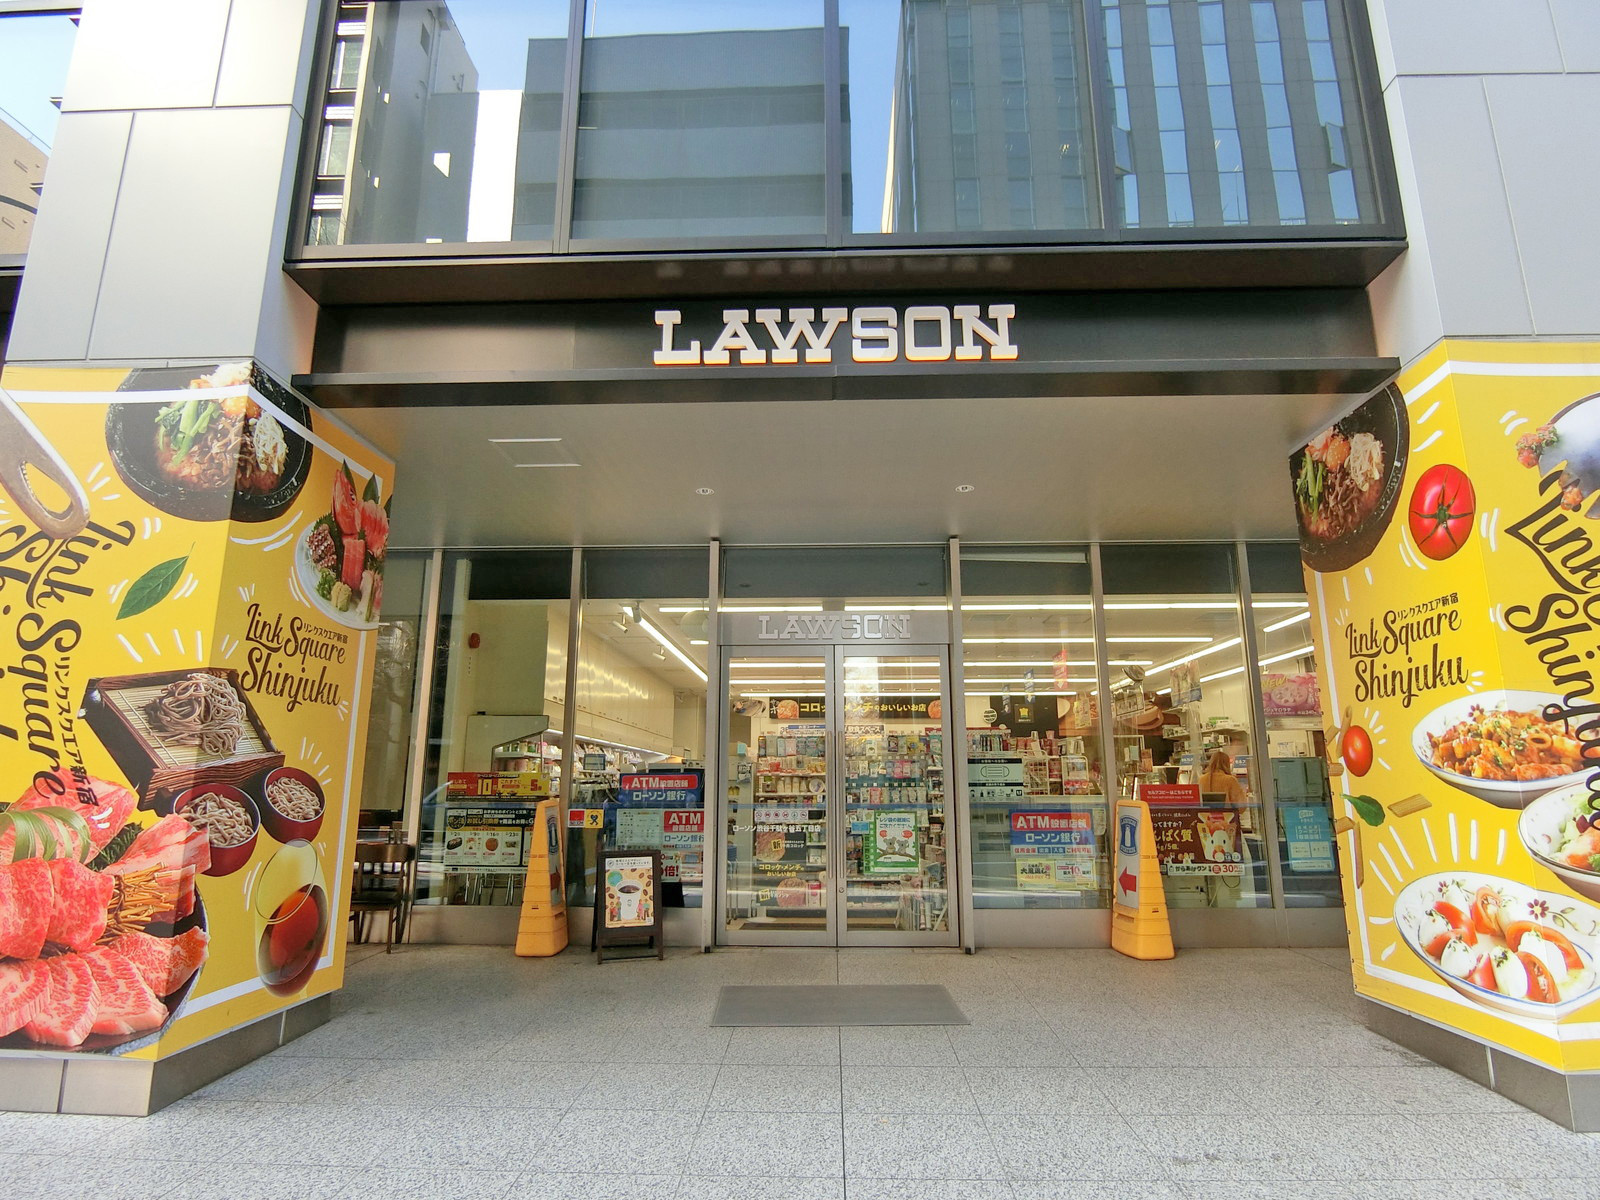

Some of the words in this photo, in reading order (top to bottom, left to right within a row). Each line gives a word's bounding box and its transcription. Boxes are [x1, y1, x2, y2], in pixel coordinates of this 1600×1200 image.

[653, 303, 1018, 365] LAWSON
[26, 520, 136, 609] Link
[245, 603, 284, 653] Link
[284, 616, 346, 665] Square
[303, 622, 348, 645] リンクスクエア新宿
[757, 615, 911, 640] LAWSON
[1345, 618, 1382, 659] Link
[1383, 609, 1462, 656] Square
[1397, 592, 1459, 621] リンクスクエア新宿
[241, 647, 341, 713] Shinjuku
[1355, 643, 1469, 708] Shinjuku
[8, 612, 82, 800] Square
[54, 656, 99, 807] リンクスクエア新宿
[1504, 591, 1600, 833] Shinju
[633, 791, 686, 800] ローソン銀行
[668, 813, 701, 824] ATM
[1025, 832, 1080, 843] ローソン銀行
[661, 865, 679, 877] 倍!
